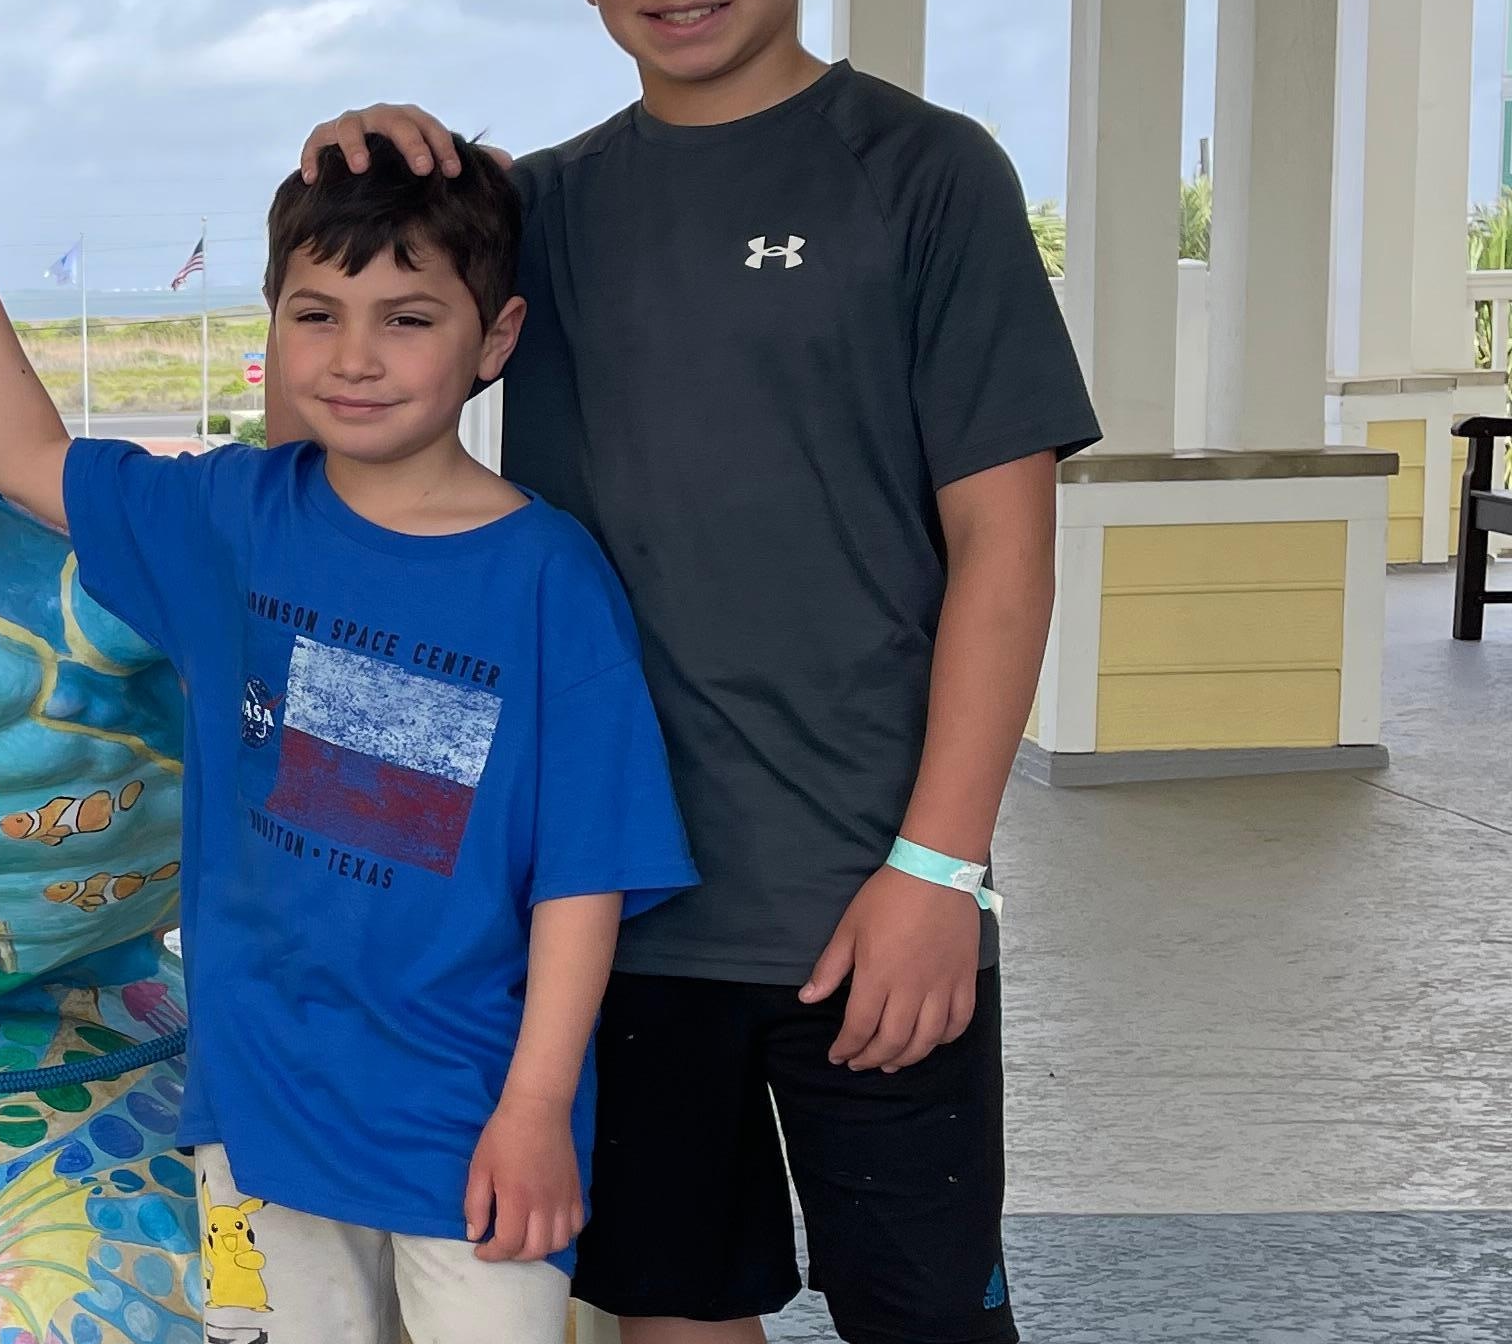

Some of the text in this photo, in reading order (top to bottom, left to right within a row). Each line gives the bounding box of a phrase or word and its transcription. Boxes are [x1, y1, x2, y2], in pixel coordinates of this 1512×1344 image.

[248, 591, 502, 689] OHNSON SPACE CENTER
[326, 847, 395, 890] TEXAS
